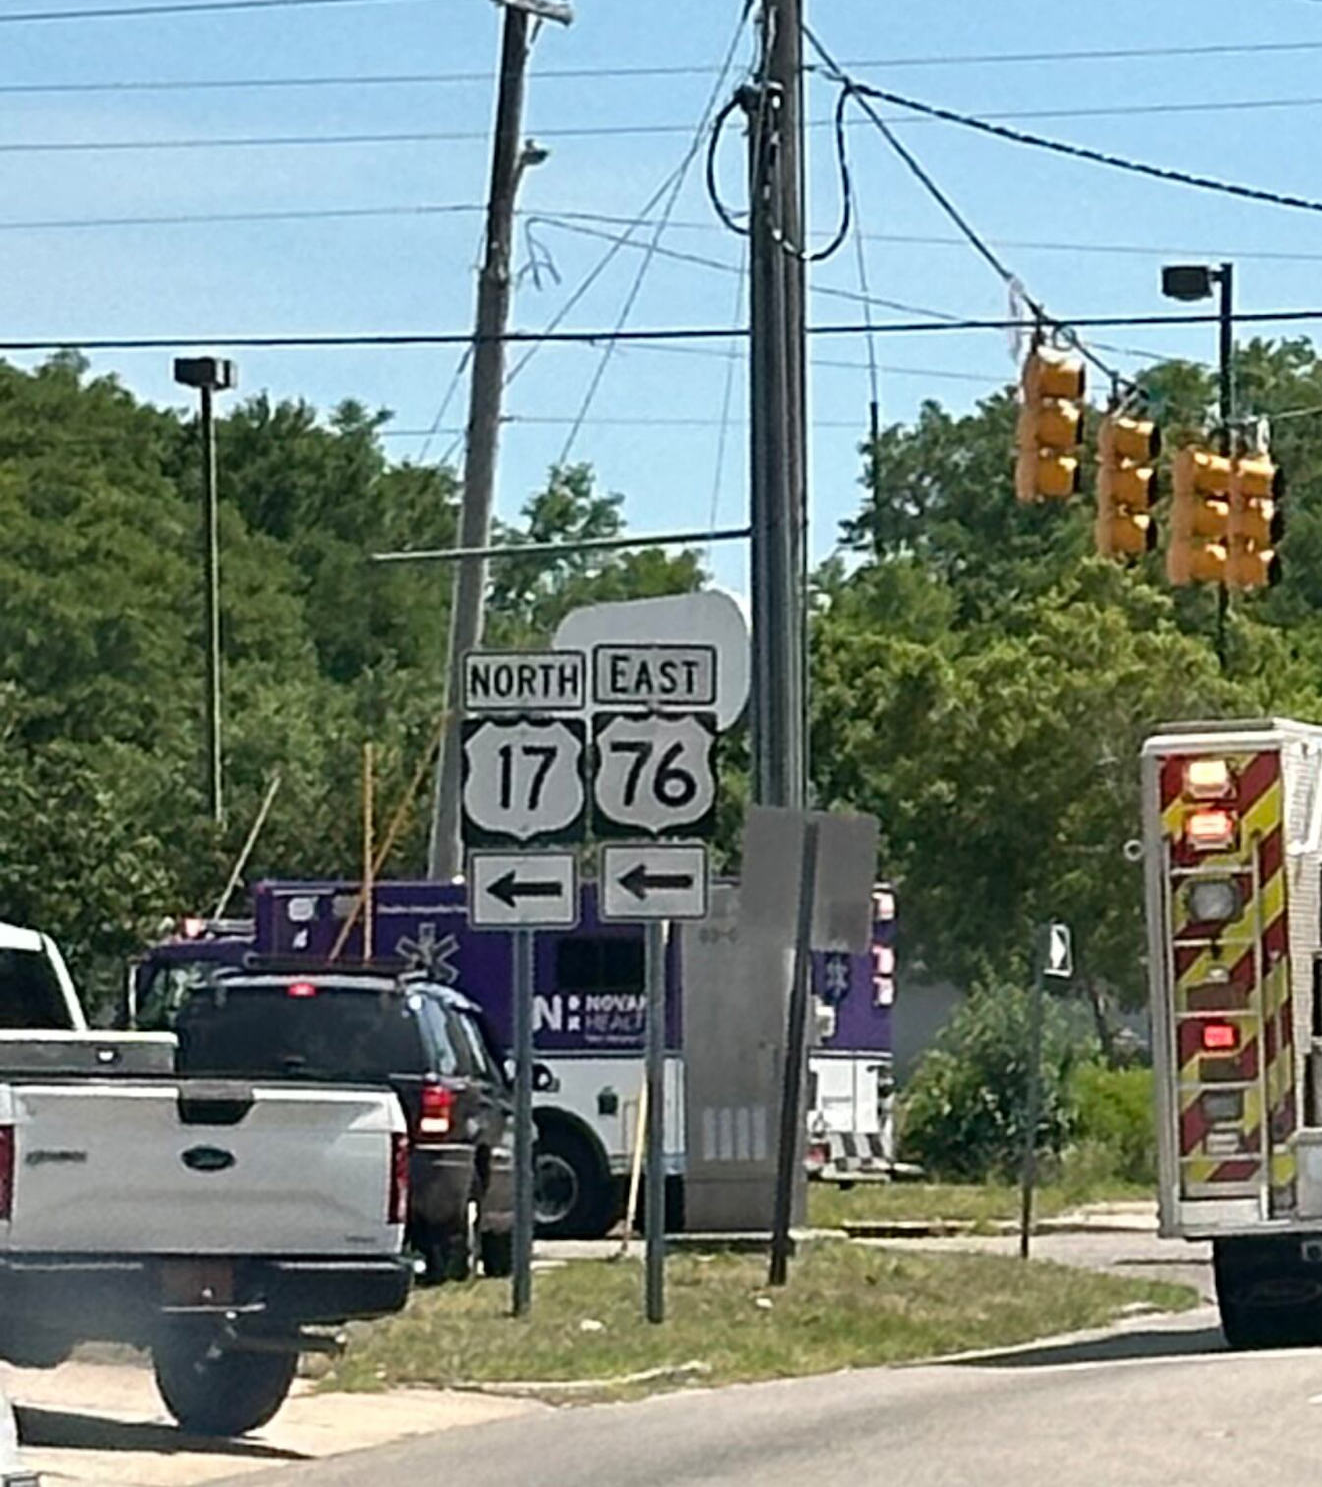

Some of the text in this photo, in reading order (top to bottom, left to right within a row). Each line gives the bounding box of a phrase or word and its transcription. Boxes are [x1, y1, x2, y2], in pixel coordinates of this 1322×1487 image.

[469, 664, 578, 698] NORTH
[610, 654, 699, 695] EAST
[498, 744, 558, 811] 17
[609, 741, 698, 808] 76
